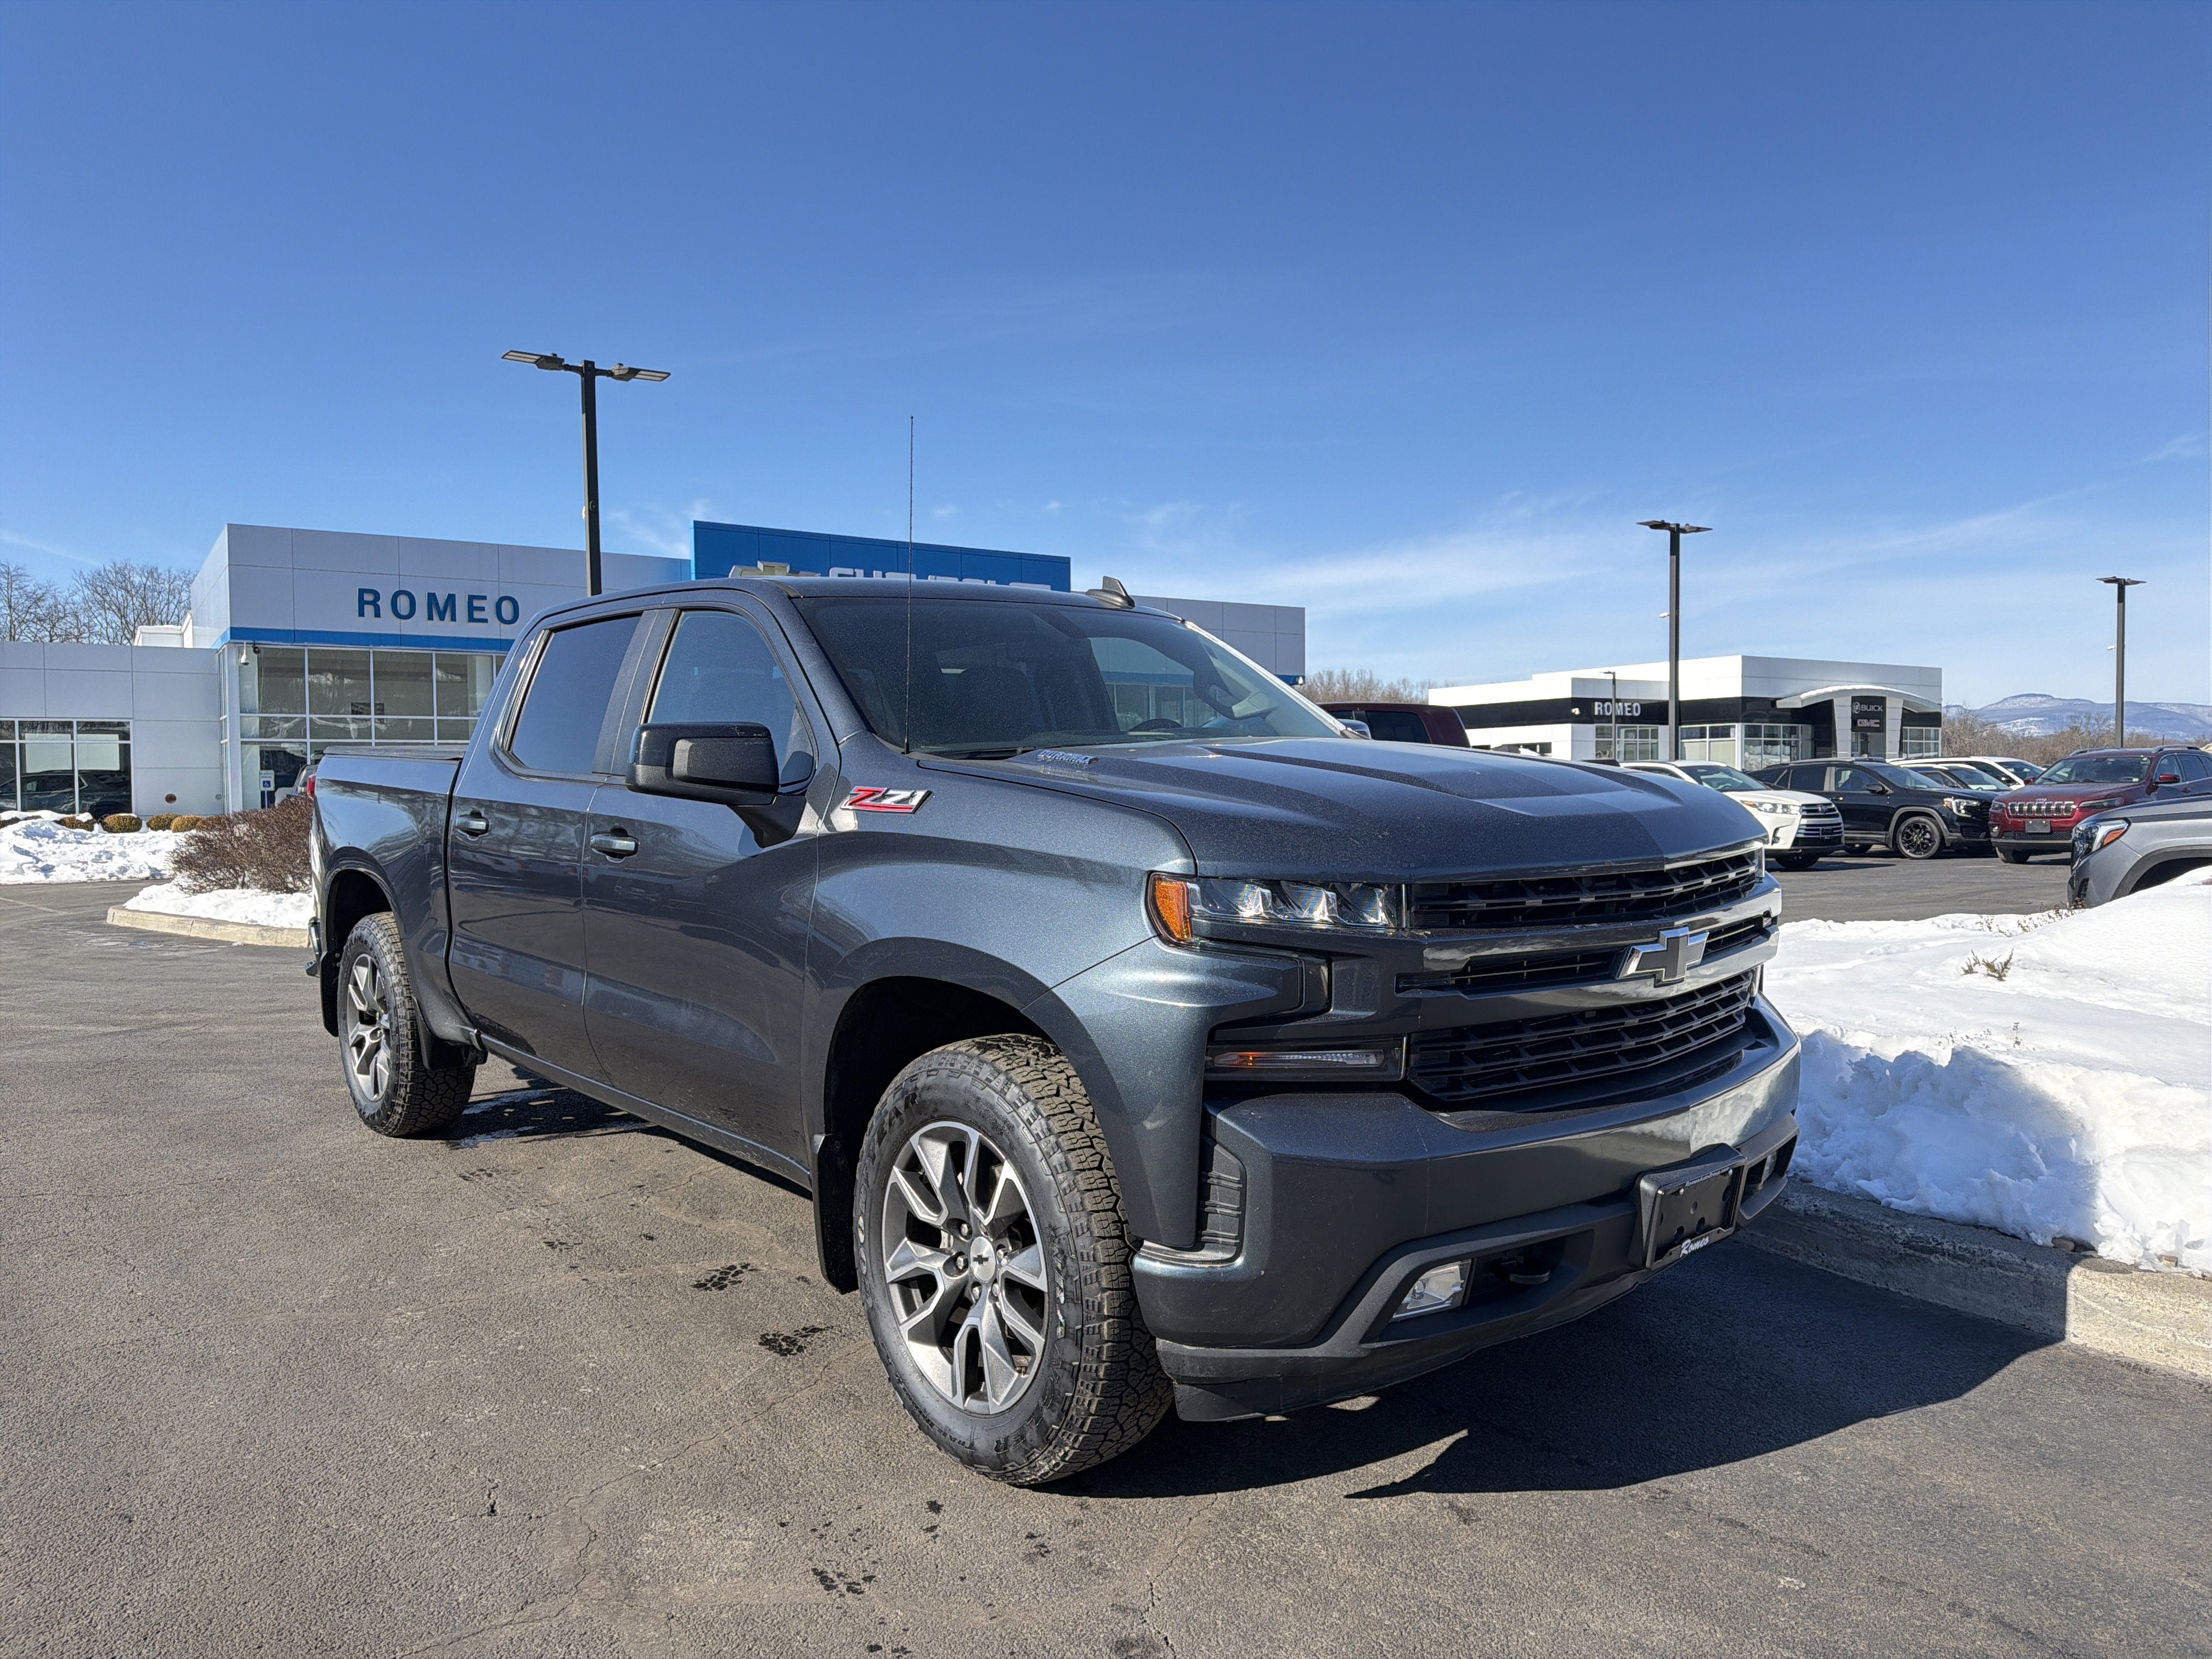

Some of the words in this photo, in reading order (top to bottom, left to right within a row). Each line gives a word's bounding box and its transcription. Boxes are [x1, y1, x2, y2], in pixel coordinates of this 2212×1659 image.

[358, 588, 520, 624] ROMEO
[1594, 702, 1641, 716] ROMEO
[1858, 719, 1880, 727] GMC
[840, 786, 932, 814] Z71
[1679, 1236, 1709, 1258] Romeo
